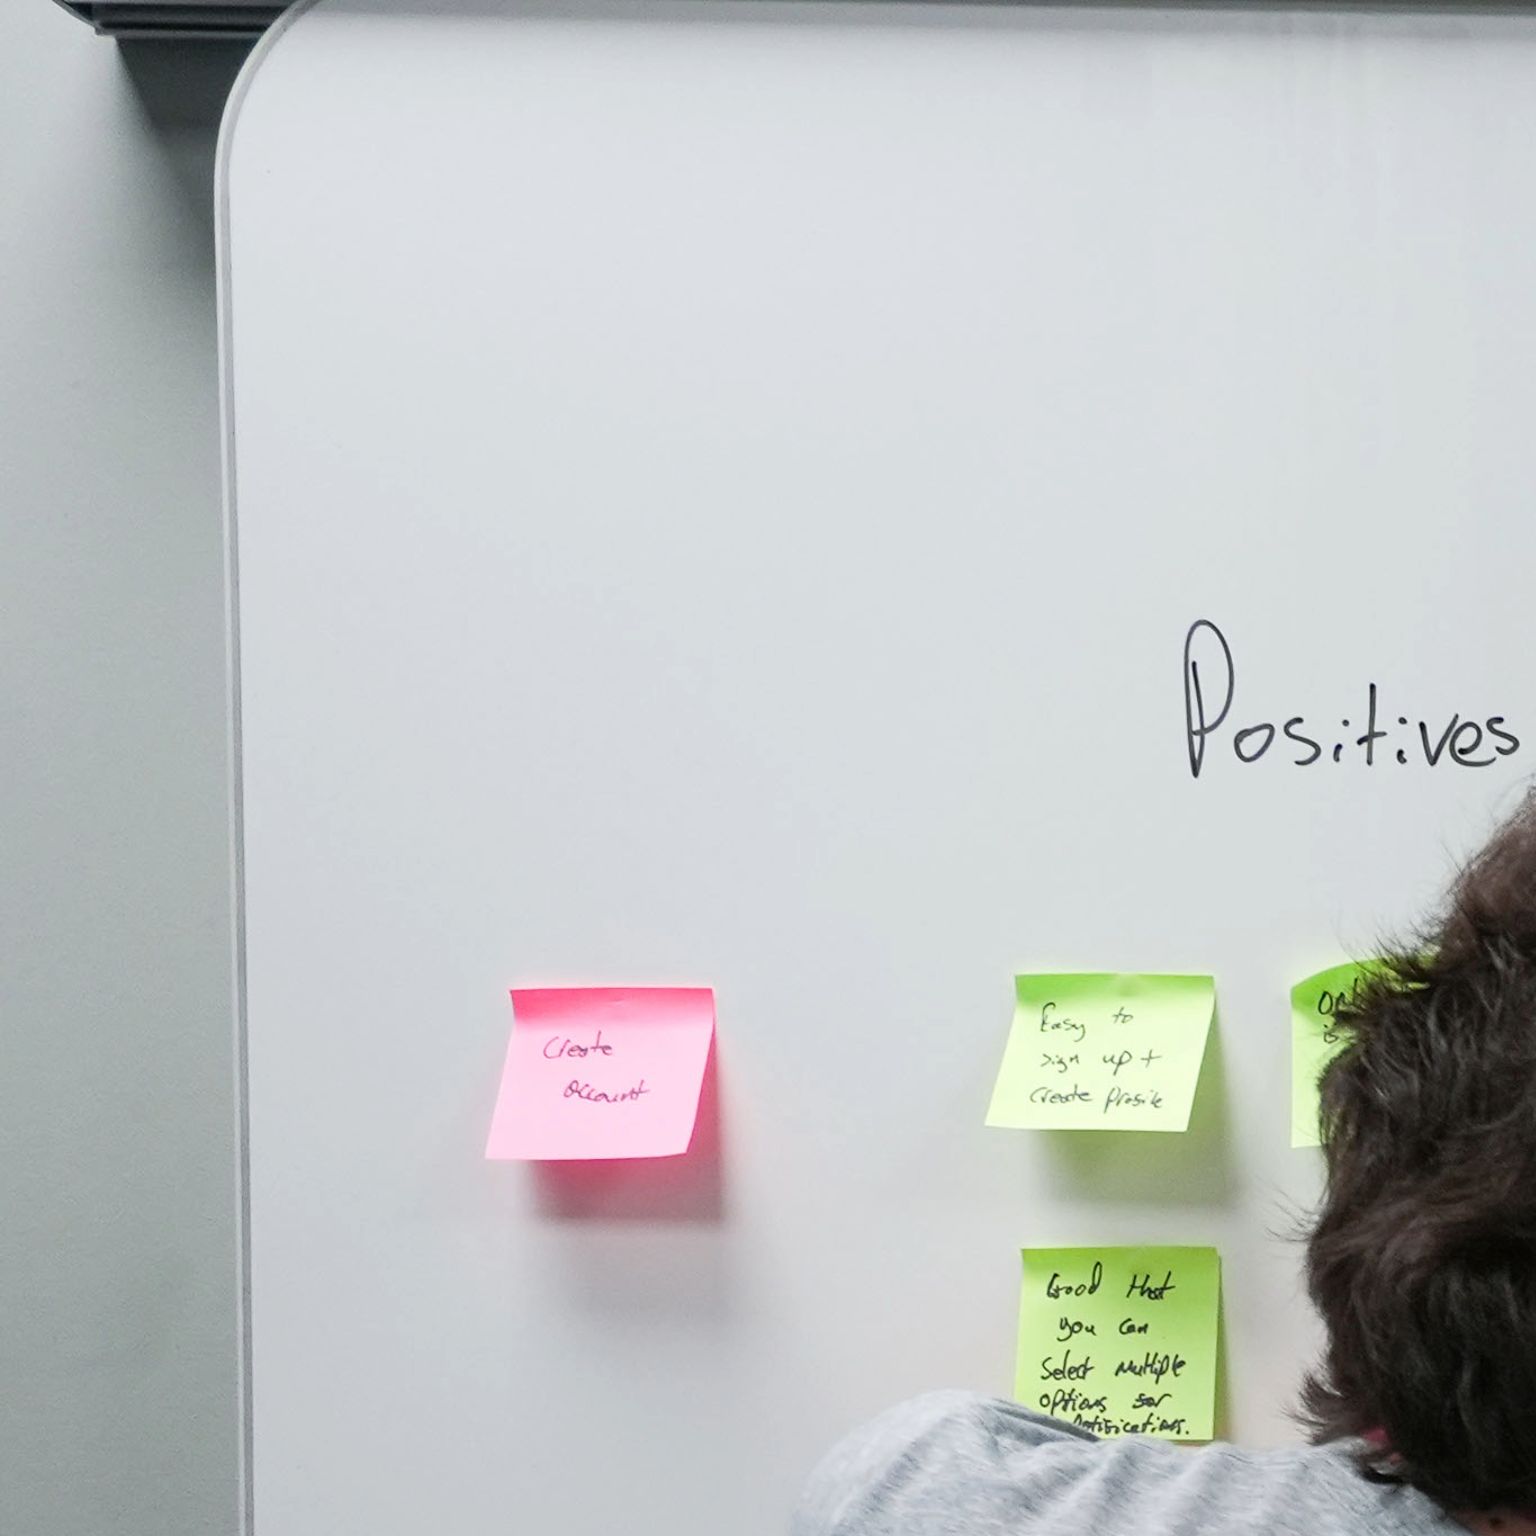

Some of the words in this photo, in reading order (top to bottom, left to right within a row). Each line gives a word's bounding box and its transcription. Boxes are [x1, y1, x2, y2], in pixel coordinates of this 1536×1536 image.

[1184, 619, 1520, 778] Positives
[1040, 1002, 1086, 1042] Easy
[1113, 1007, 1133, 1023] to
[1102, 1051, 1133, 1075] up
[1047, 1261, 1102, 1299] Good
[1057, 1317, 1097, 1341] you
